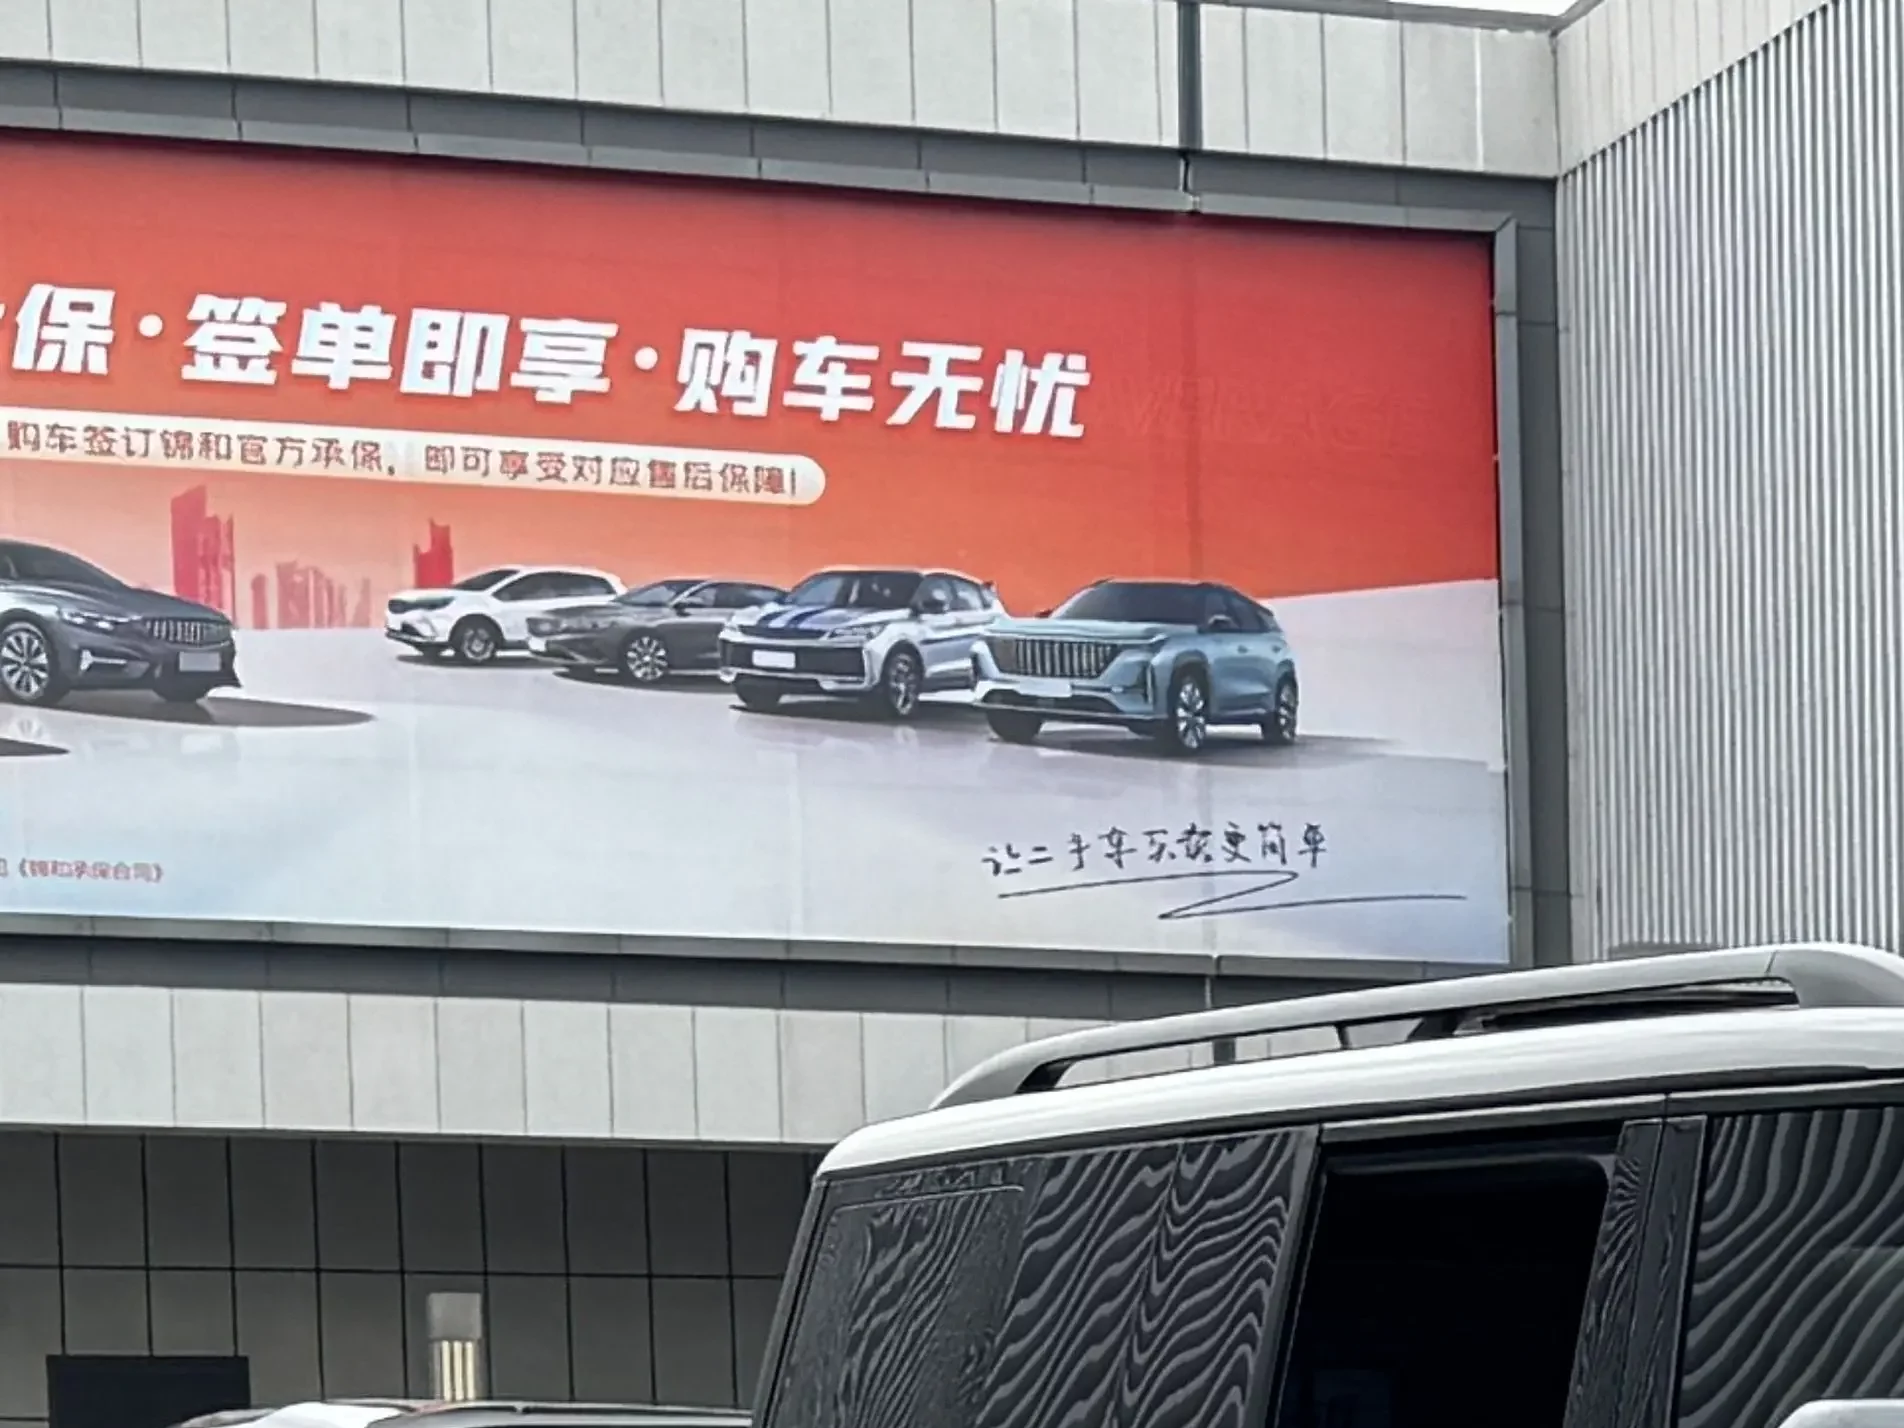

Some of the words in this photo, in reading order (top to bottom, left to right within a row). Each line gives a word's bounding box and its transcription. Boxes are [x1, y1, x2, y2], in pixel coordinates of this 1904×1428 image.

[0, 284, 1089, 437] 保·签单即享·购车无忧
